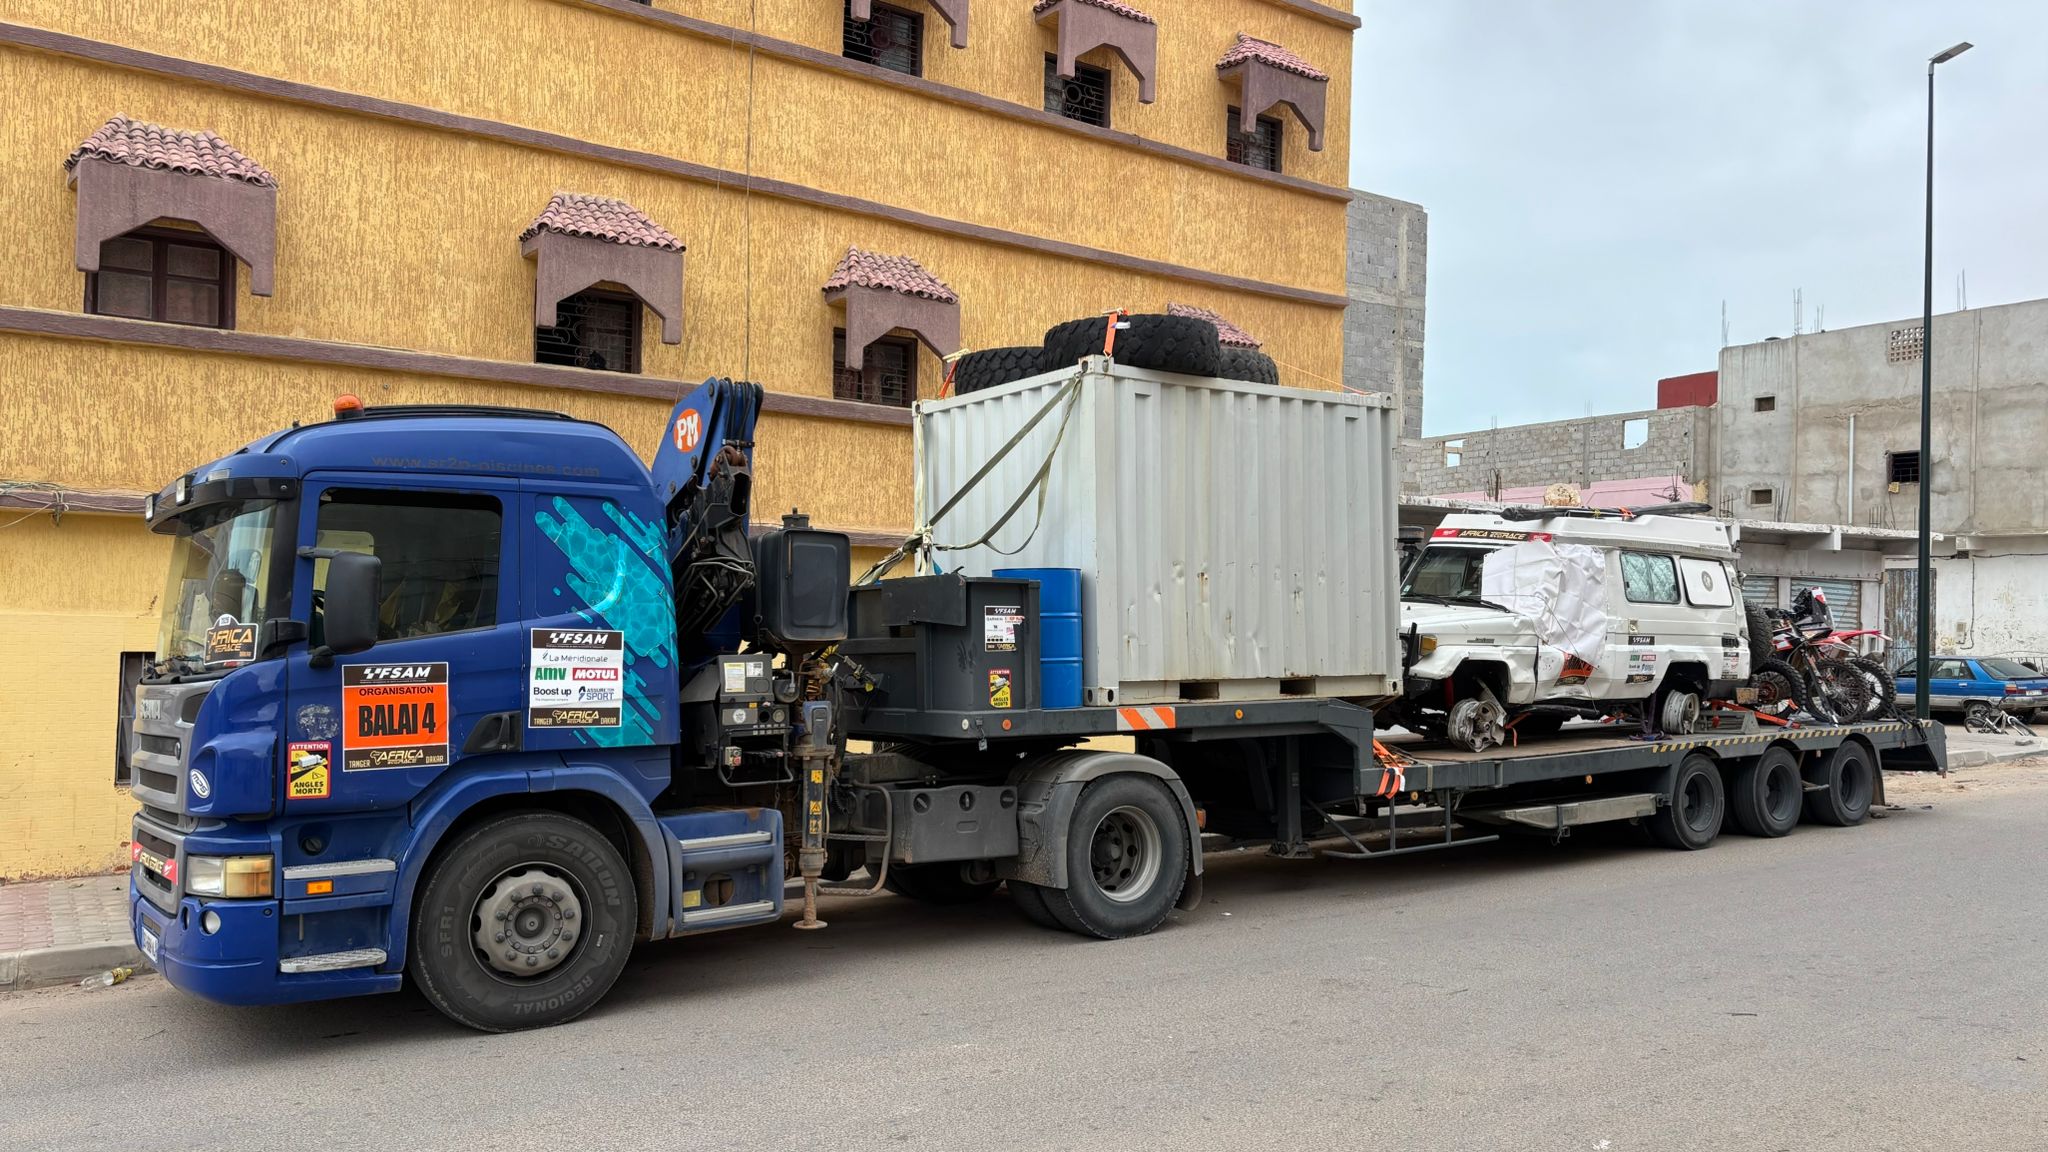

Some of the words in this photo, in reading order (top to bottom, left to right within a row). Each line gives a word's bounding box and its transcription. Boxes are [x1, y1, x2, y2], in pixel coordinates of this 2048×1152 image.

[676, 412, 699, 450] PM
[562, 633, 609, 645] FSAM
[378, 666, 432, 679] FSAM
[574, 669, 617, 679] MOTUL
[359, 686, 434, 696] ORGANISATION
[533, 687, 560, 696] Boost
[560, 688, 572, 697] up
[586, 692, 615, 700] SPORT
[358, 703, 418, 737] BALAI
[422, 702, 436, 734] 4
[558, 710, 600, 720] AFRICA
[534, 718, 553, 726] TANGER
[600, 717, 617, 725] DAKAR
[377, 749, 424, 761] AFRICA
[425, 755, 444, 764] DAKAR
[348, 759, 371, 769] TANGER
[295, 787, 323, 795] MORTS
[545, 834, 621, 907] SAILUN
[512, 973, 595, 1016] REGIONAL
